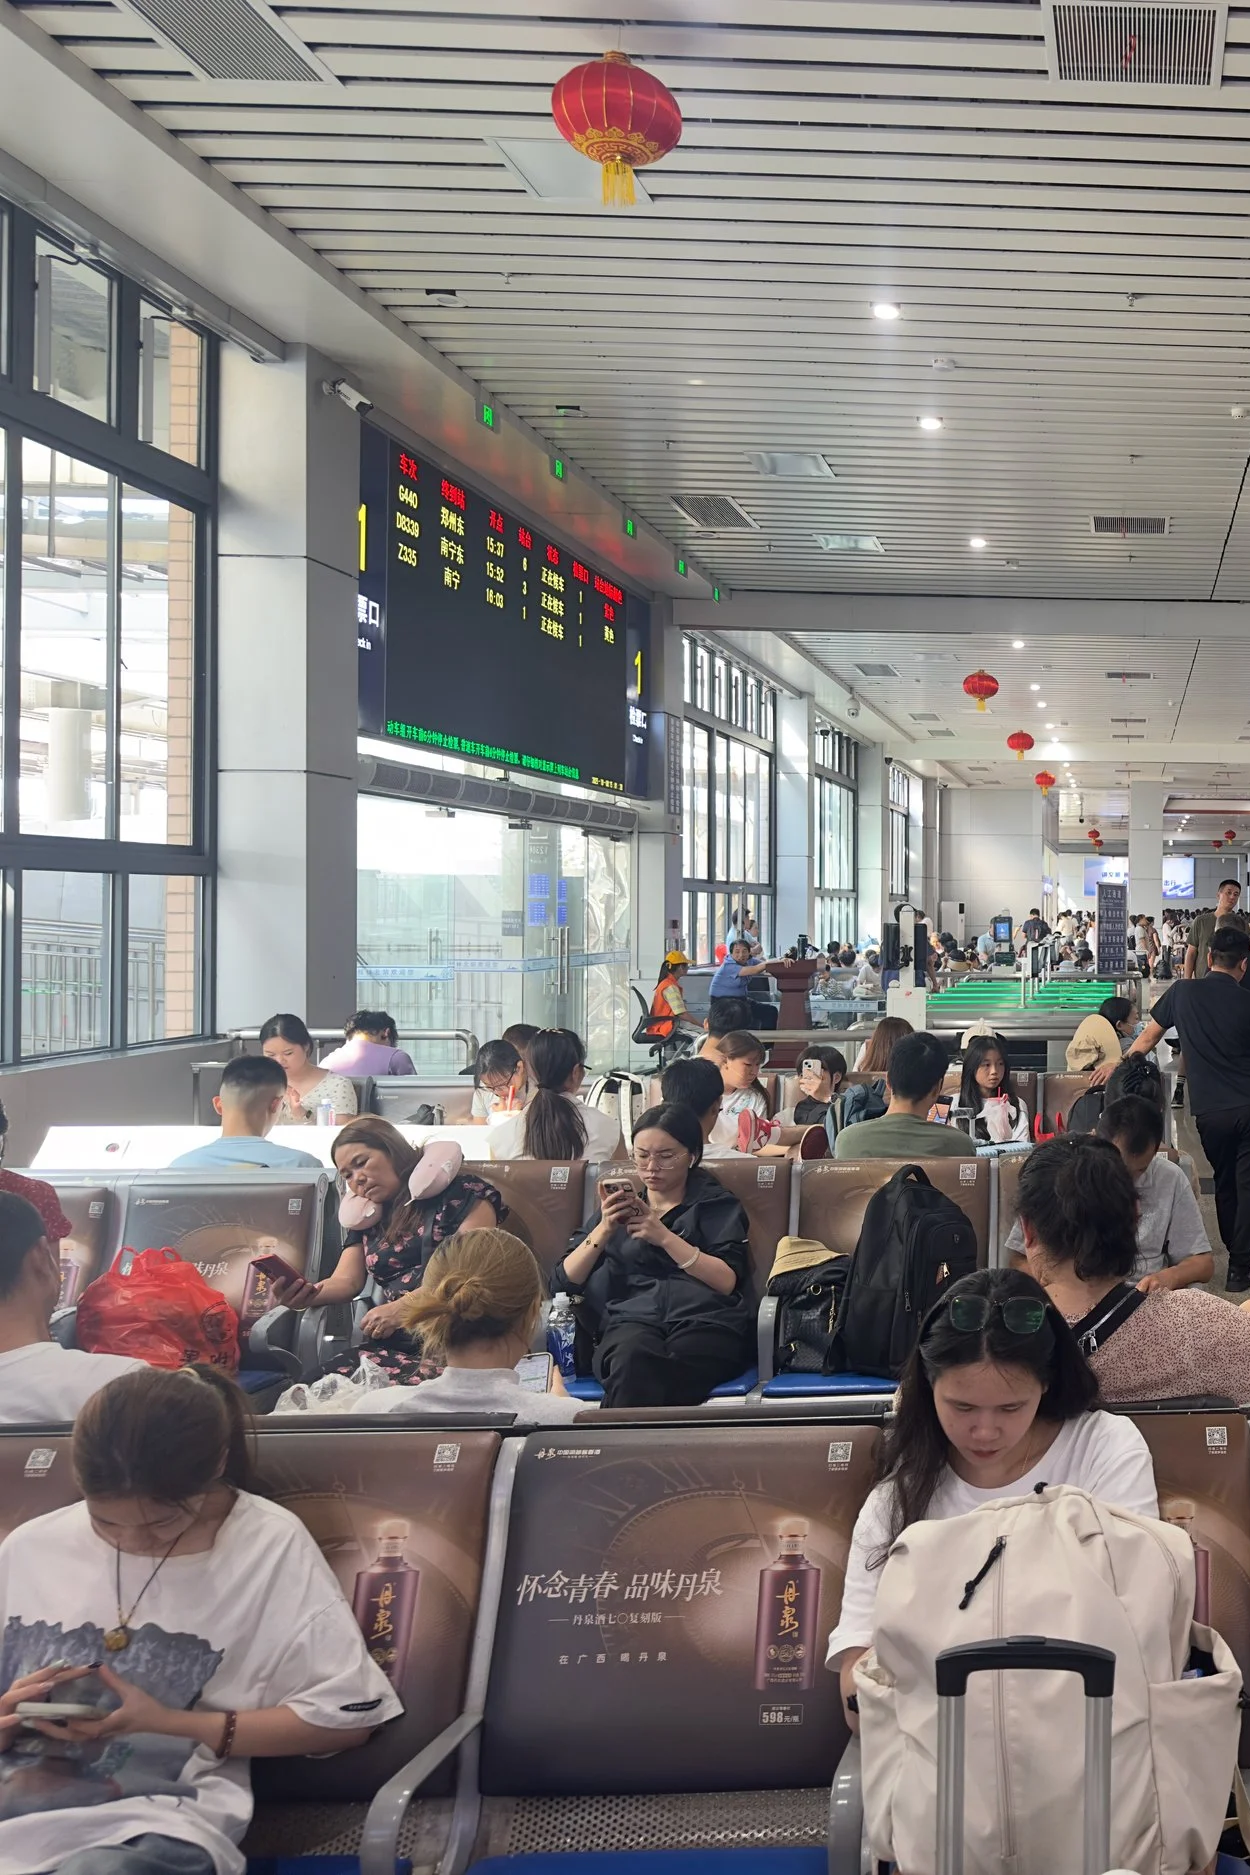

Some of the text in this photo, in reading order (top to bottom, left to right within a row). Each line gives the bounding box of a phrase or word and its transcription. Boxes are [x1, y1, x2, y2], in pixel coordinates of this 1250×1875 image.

[400, 453, 418, 481] 车次
[398, 484, 418, 509] G440
[396, 511, 419, 538] D8339
[440, 506, 465, 536] 郑州东
[489, 509, 504, 534] 开点
[358, 503, 367, 572] 1
[486, 536, 505, 558] 15:37
[397, 542, 417, 567] Z335
[440, 536, 465, 565] 南宁东
[486, 561, 505, 583] 15:52
[522, 557, 528, 571] 6
[443, 566, 461, 590] 南宁
[522, 581, 527, 595] 3
[541, 566, 565, 592] 正在候车
[486, 587, 504, 609] 16:03
[540, 591, 565, 617] 正在候车
[540, 615, 565, 641] 正在候车
[634, 650, 642, 695] 1
[516, 1567, 724, 1606] 怀念青春 品味丹泉
[558, 1652, 606, 1665] 在广西
